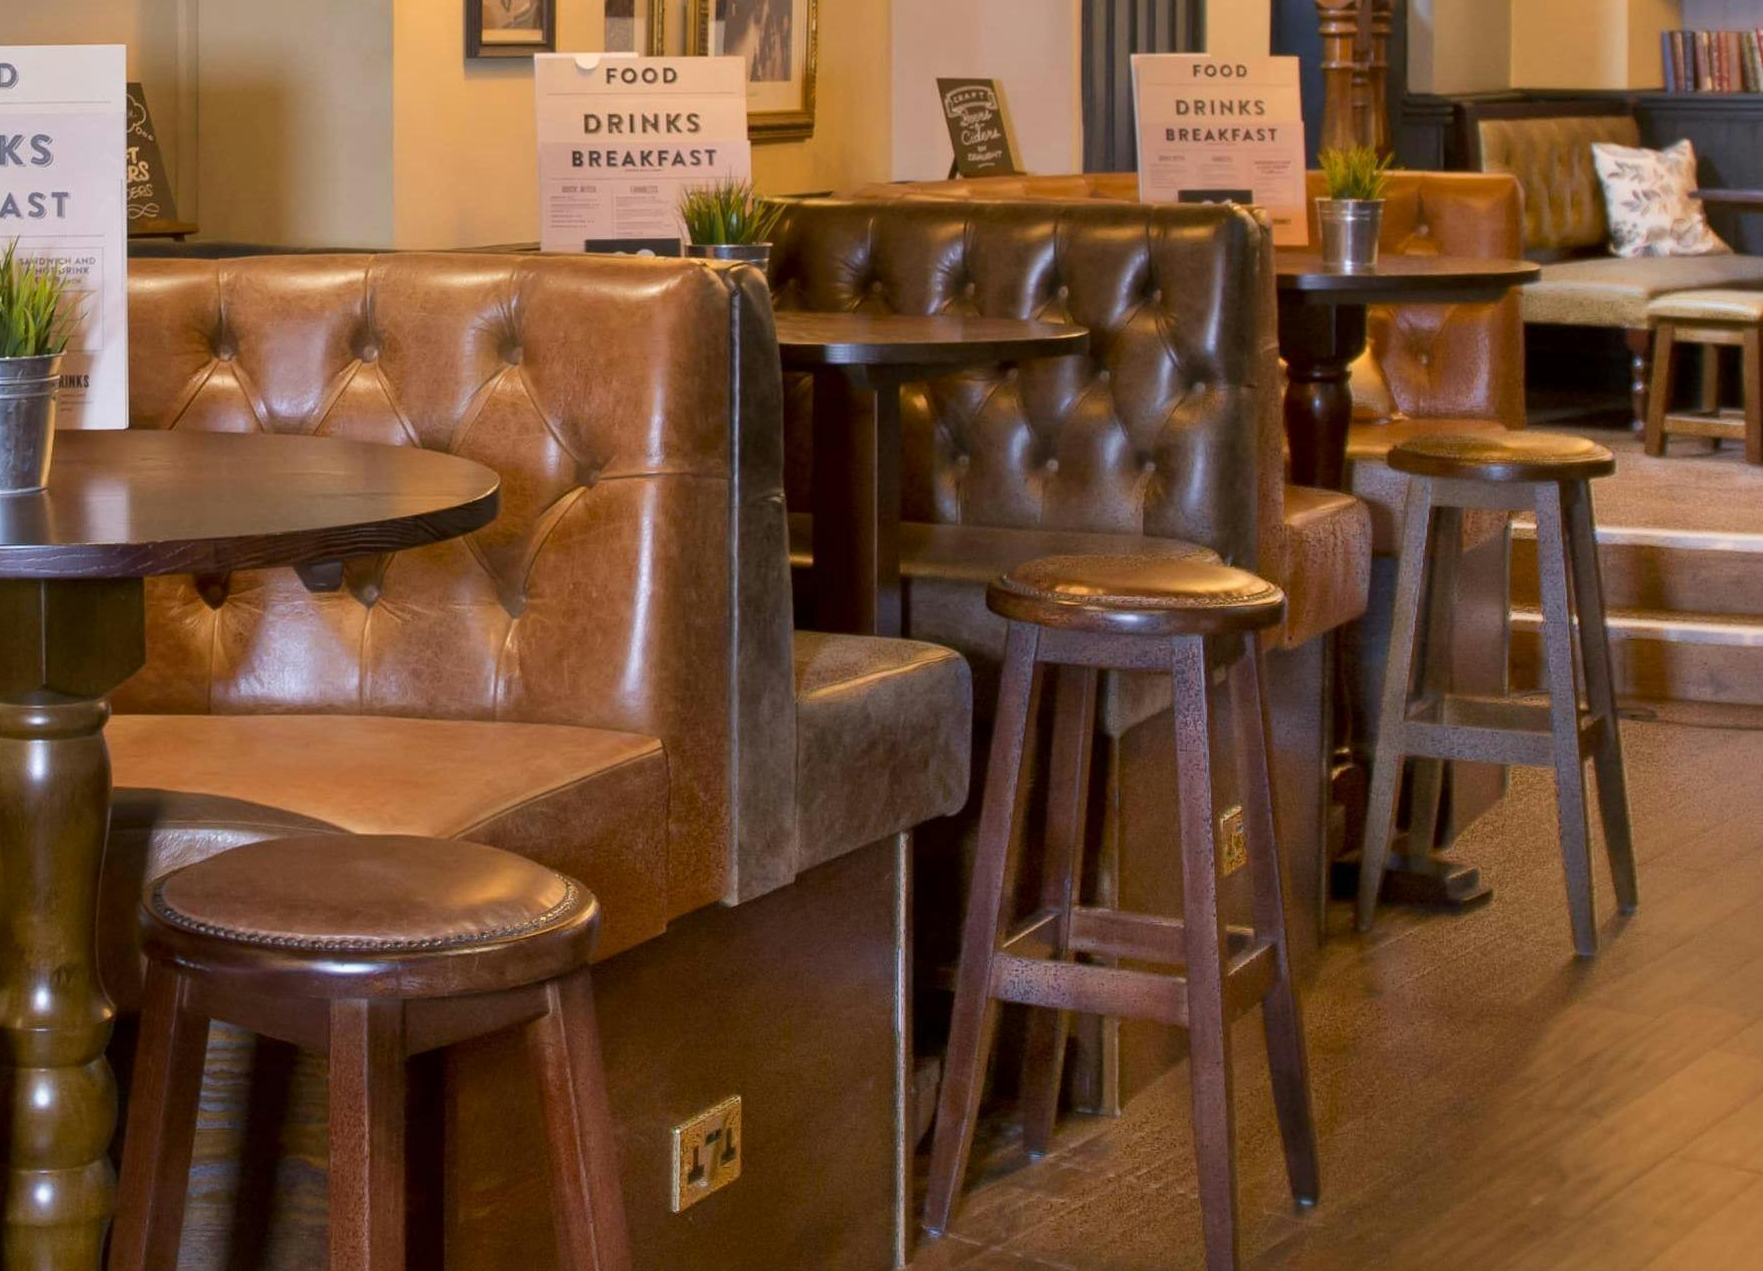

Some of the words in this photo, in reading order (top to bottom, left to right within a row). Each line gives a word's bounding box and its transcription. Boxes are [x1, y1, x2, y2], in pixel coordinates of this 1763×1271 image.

[606, 67, 678, 84] FOOD
[1192, 64, 1248, 78] FOOD
[953, 91, 985, 103] CRAFT
[1175, 99, 1266, 116] DRINKS
[583, 113, 702, 135] DRINKS
[961, 128, 1001, 145] Ciders
[1165, 128, 1277, 142] BREAKFAST
[571, 150, 716, 168] BREAKFAST
[75, 257, 96, 265] AND
[58, 375, 90, 389] RINKS
